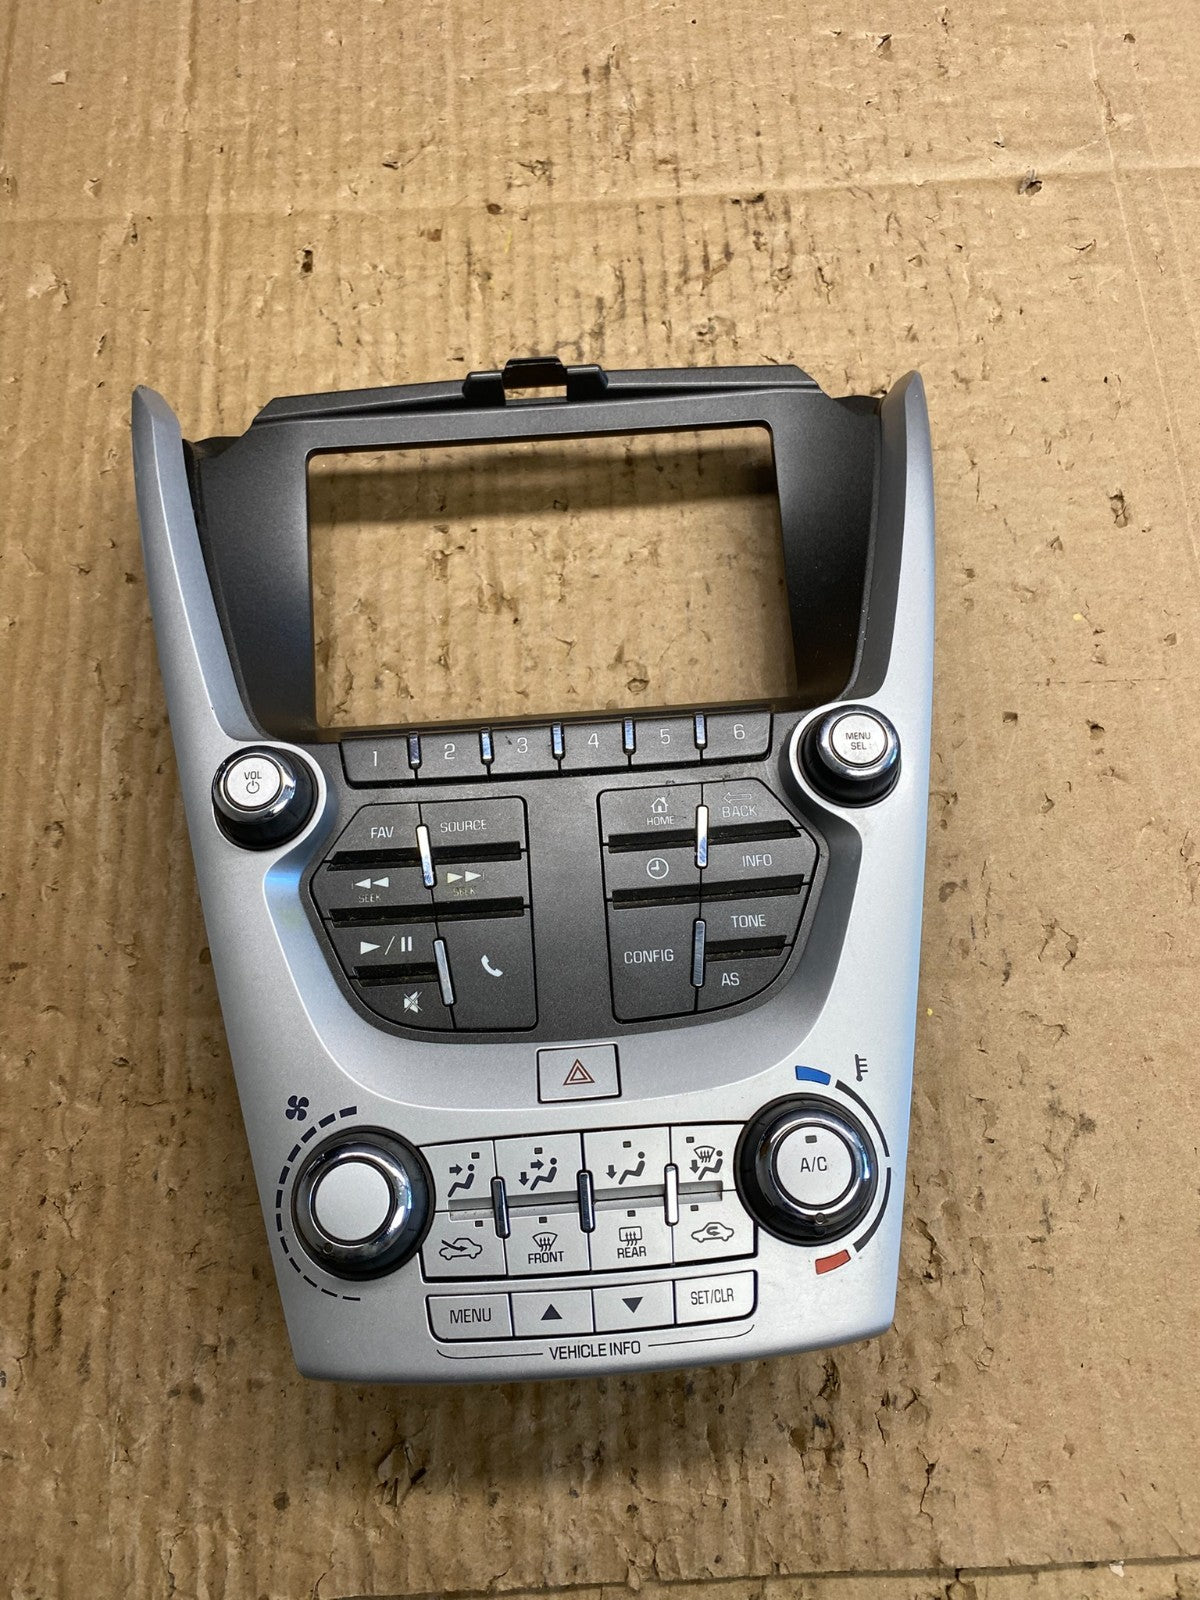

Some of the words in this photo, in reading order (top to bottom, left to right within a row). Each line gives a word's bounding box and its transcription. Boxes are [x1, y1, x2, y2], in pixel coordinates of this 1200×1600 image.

[660, 729, 671, 745] 5
[733, 724, 746, 741] 6
[845, 731, 872, 742] MENU
[517, 737, 529, 754] 3
[587, 733, 600, 749] 4
[850, 740, 868, 751] SEL
[372, 750, 379, 767] 1
[443, 743, 456, 760] 2
[243, 771, 262, 781] VOL
[722, 804, 758, 818] BACK
[440, 818, 488, 833] SOURCE
[646, 816, 675, 826] HOME
[370, 826, 394, 839] FAV
[742, 854, 773, 867] INFO
[358, 893, 382, 903] SEEK
[453, 886, 477, 897] SEEK
[731, 913, 767, 928] TONE
[624, 949, 675, 964] CONFIG
[721, 972, 740, 987] AS
[799, 1155, 828, 1173] A/C
[527, 1250, 565, 1264] FRONT
[616, 1245, 648, 1259] REAR
[690, 1287, 735, 1306] SET/CLR
[449, 1307, 492, 1325] MENU
[548, 1343, 607, 1361] VEHICLE
[609, 1340, 642, 1357] INFO
